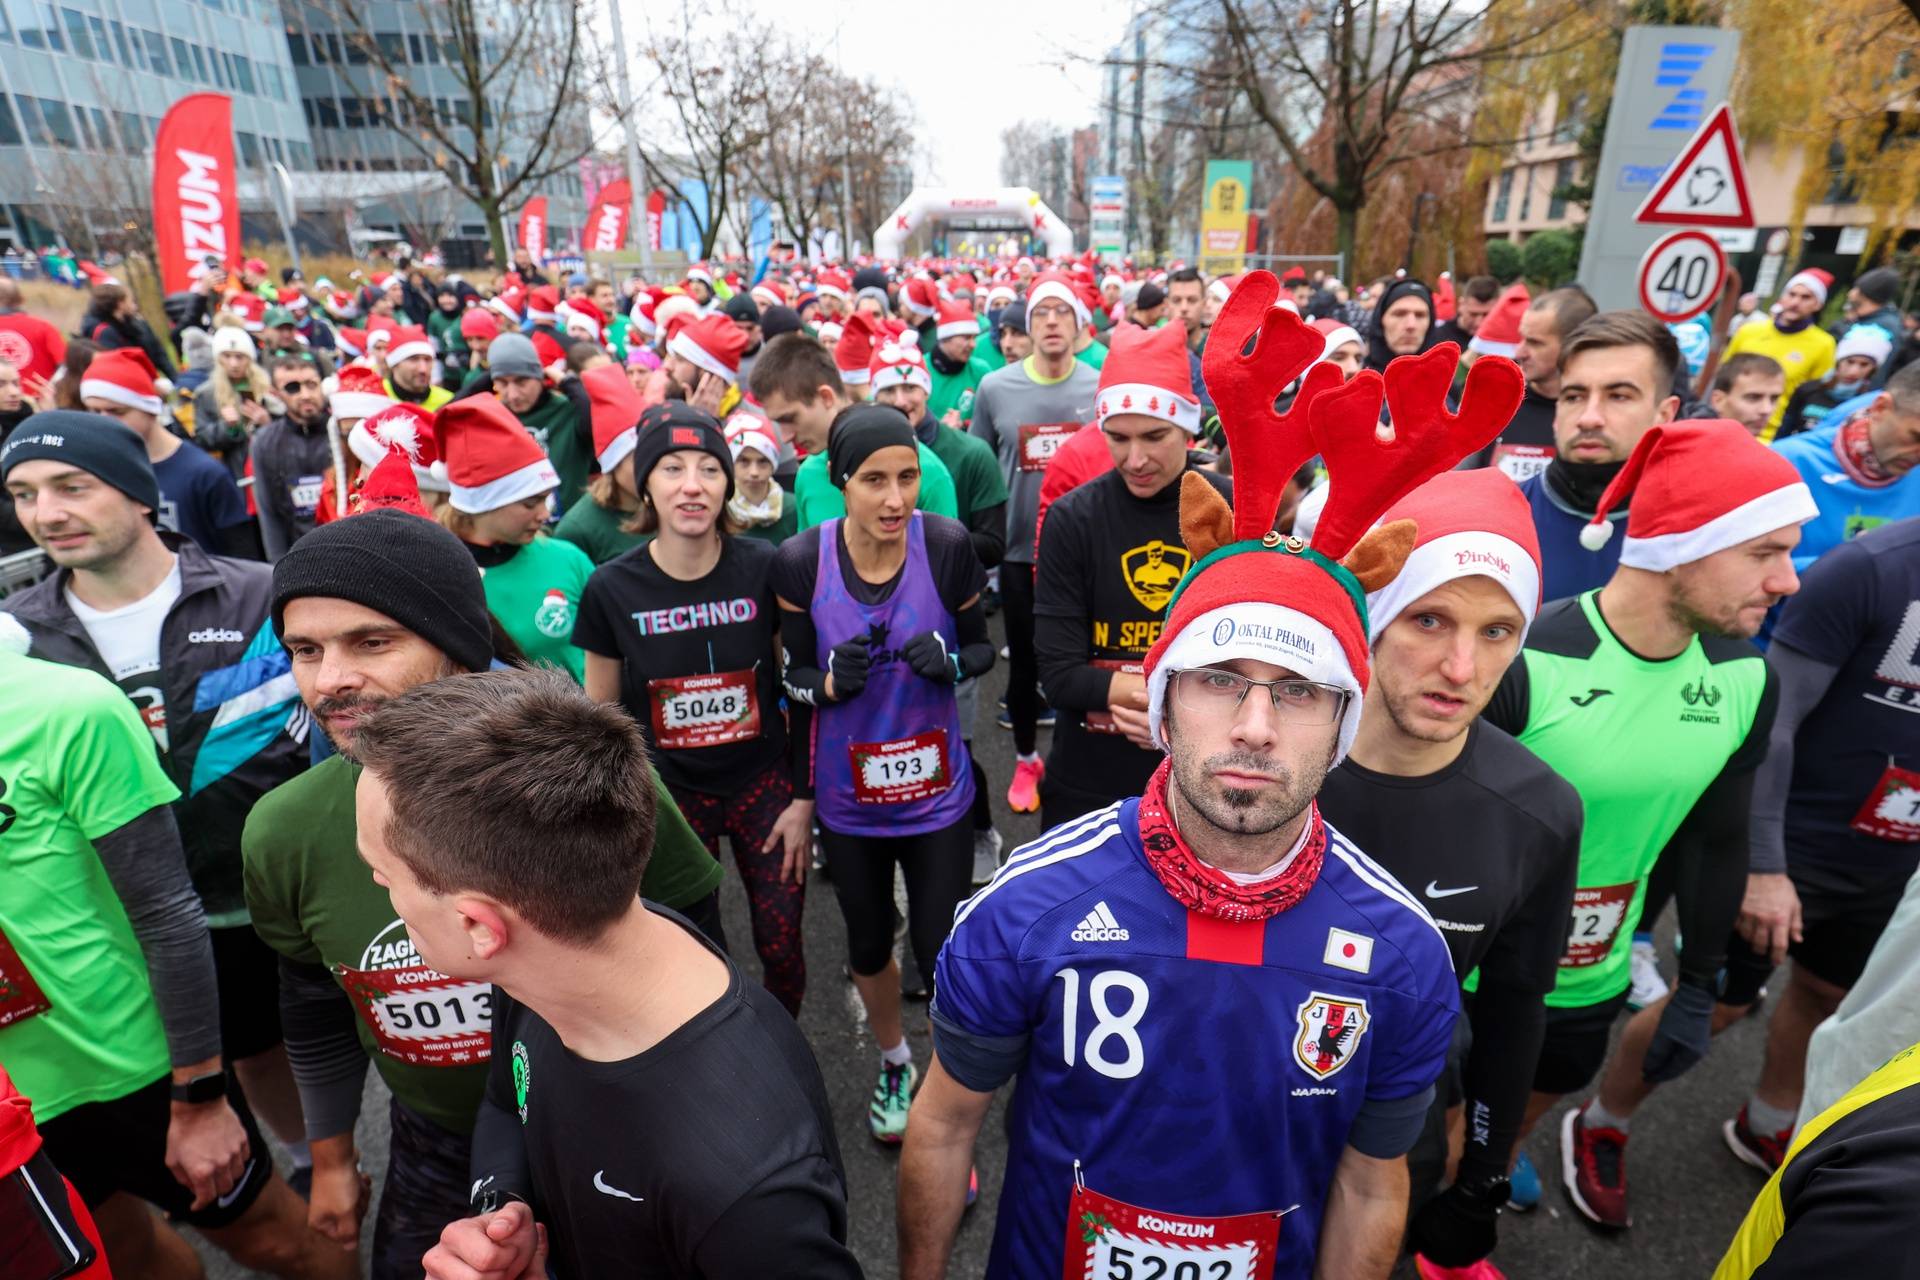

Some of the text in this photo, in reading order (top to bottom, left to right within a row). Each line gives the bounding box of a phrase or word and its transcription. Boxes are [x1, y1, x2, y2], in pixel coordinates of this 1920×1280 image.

[176, 148, 227, 293] NZUM
[1657, 256, 1708, 300] 40
[631, 597, 758, 636] TECHNO
[188, 627, 244, 644] adidas
[1238, 622, 1316, 656] OKTAL PHARMA
[683, 677, 723, 689] KONZUM
[674, 695, 736, 721] 5048
[880, 757, 922, 780] 193
[1070, 927, 1130, 942] adidas
[384, 992, 492, 1029] 5013
[1055, 967, 1150, 1079] 18
[423, 1042, 451, 1051] MIRKO
[1290, 1087, 1338, 1097] JAPAN
[1137, 1214, 1216, 1239] KONZUM
[1107, 1246, 1233, 1280] 5202
